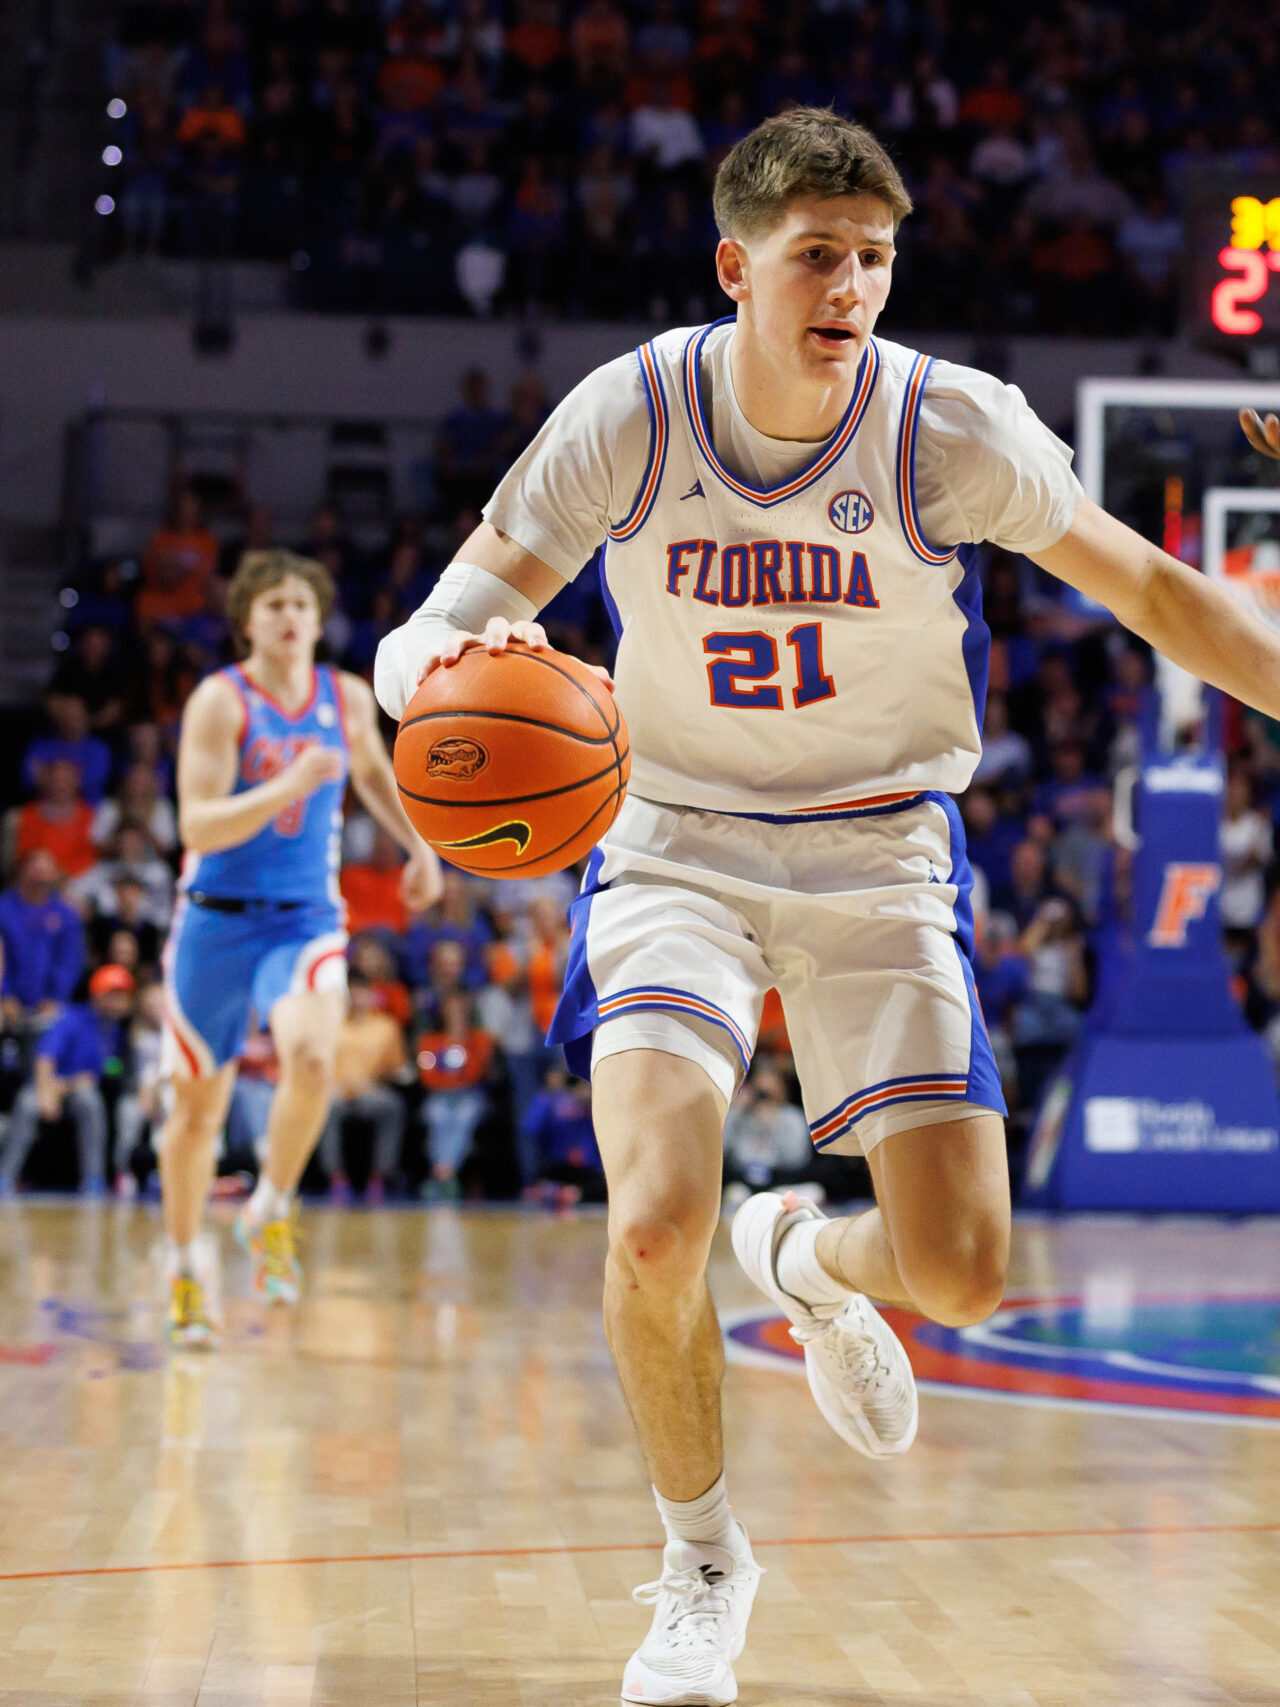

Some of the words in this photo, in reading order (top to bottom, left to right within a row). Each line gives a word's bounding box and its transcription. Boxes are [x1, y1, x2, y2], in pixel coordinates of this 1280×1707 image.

[833, 493, 870, 532] SEC
[666, 538, 880, 609] FLORIDA
[702, 622, 837, 710] 21
[1149, 862, 1223, 948] F
